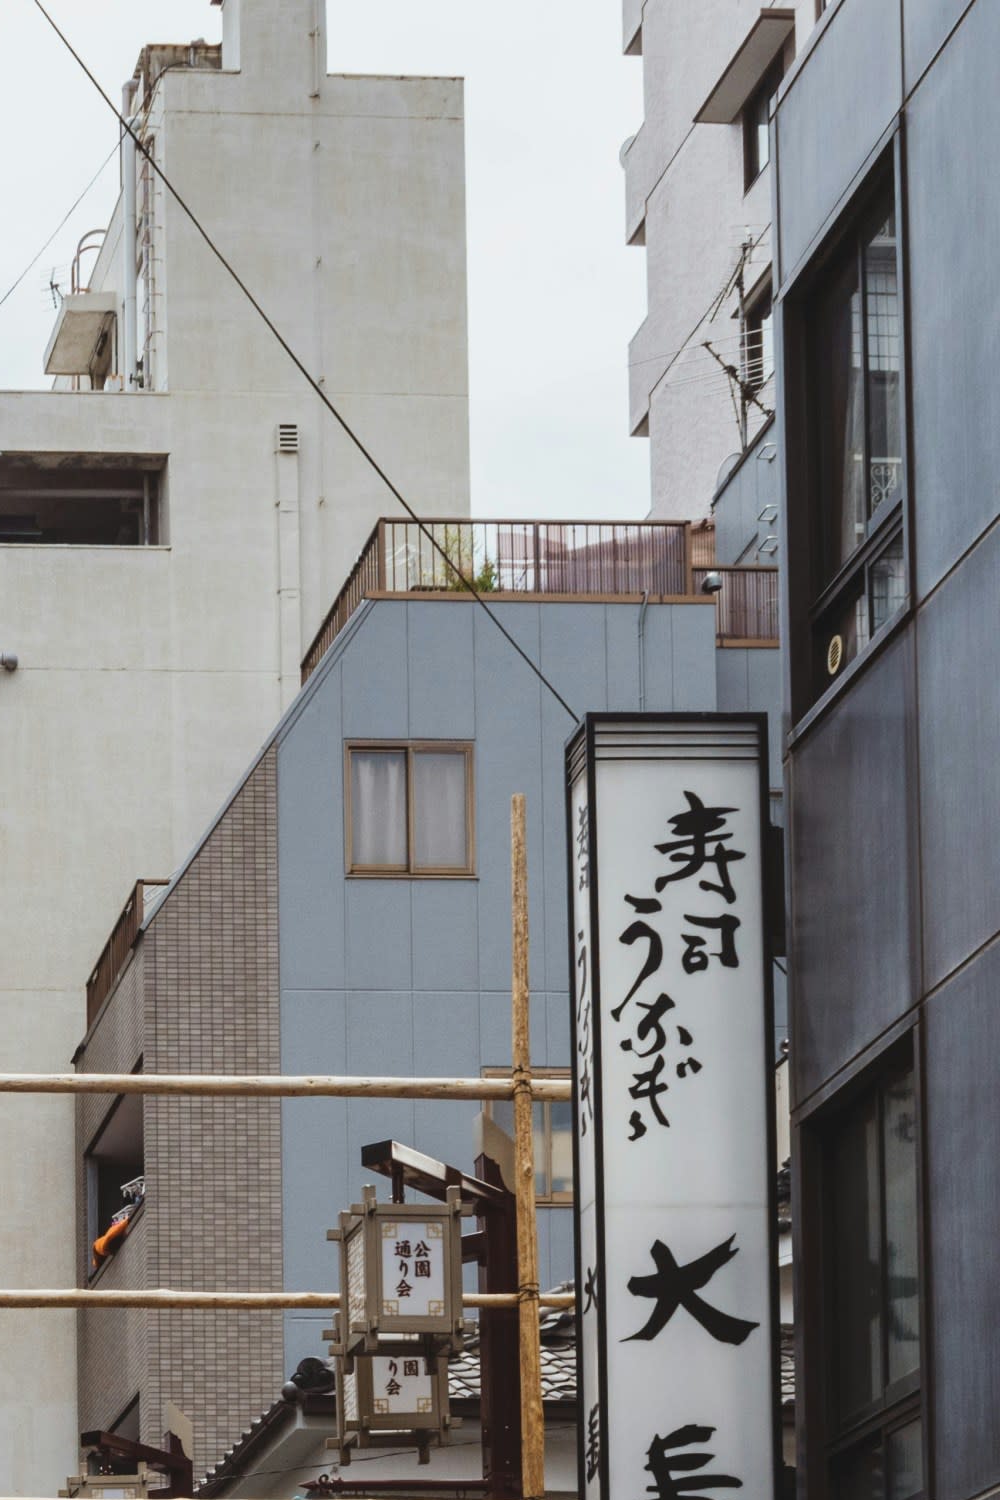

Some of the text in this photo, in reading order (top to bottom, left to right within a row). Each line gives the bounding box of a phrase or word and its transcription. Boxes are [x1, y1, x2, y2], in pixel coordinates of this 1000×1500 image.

[654, 790, 746, 975] 寿司
[610, 893, 703, 1142] うなぎ
[394, 1240, 413, 1298] 通り会
[413, 1240, 432, 1278] 公園
